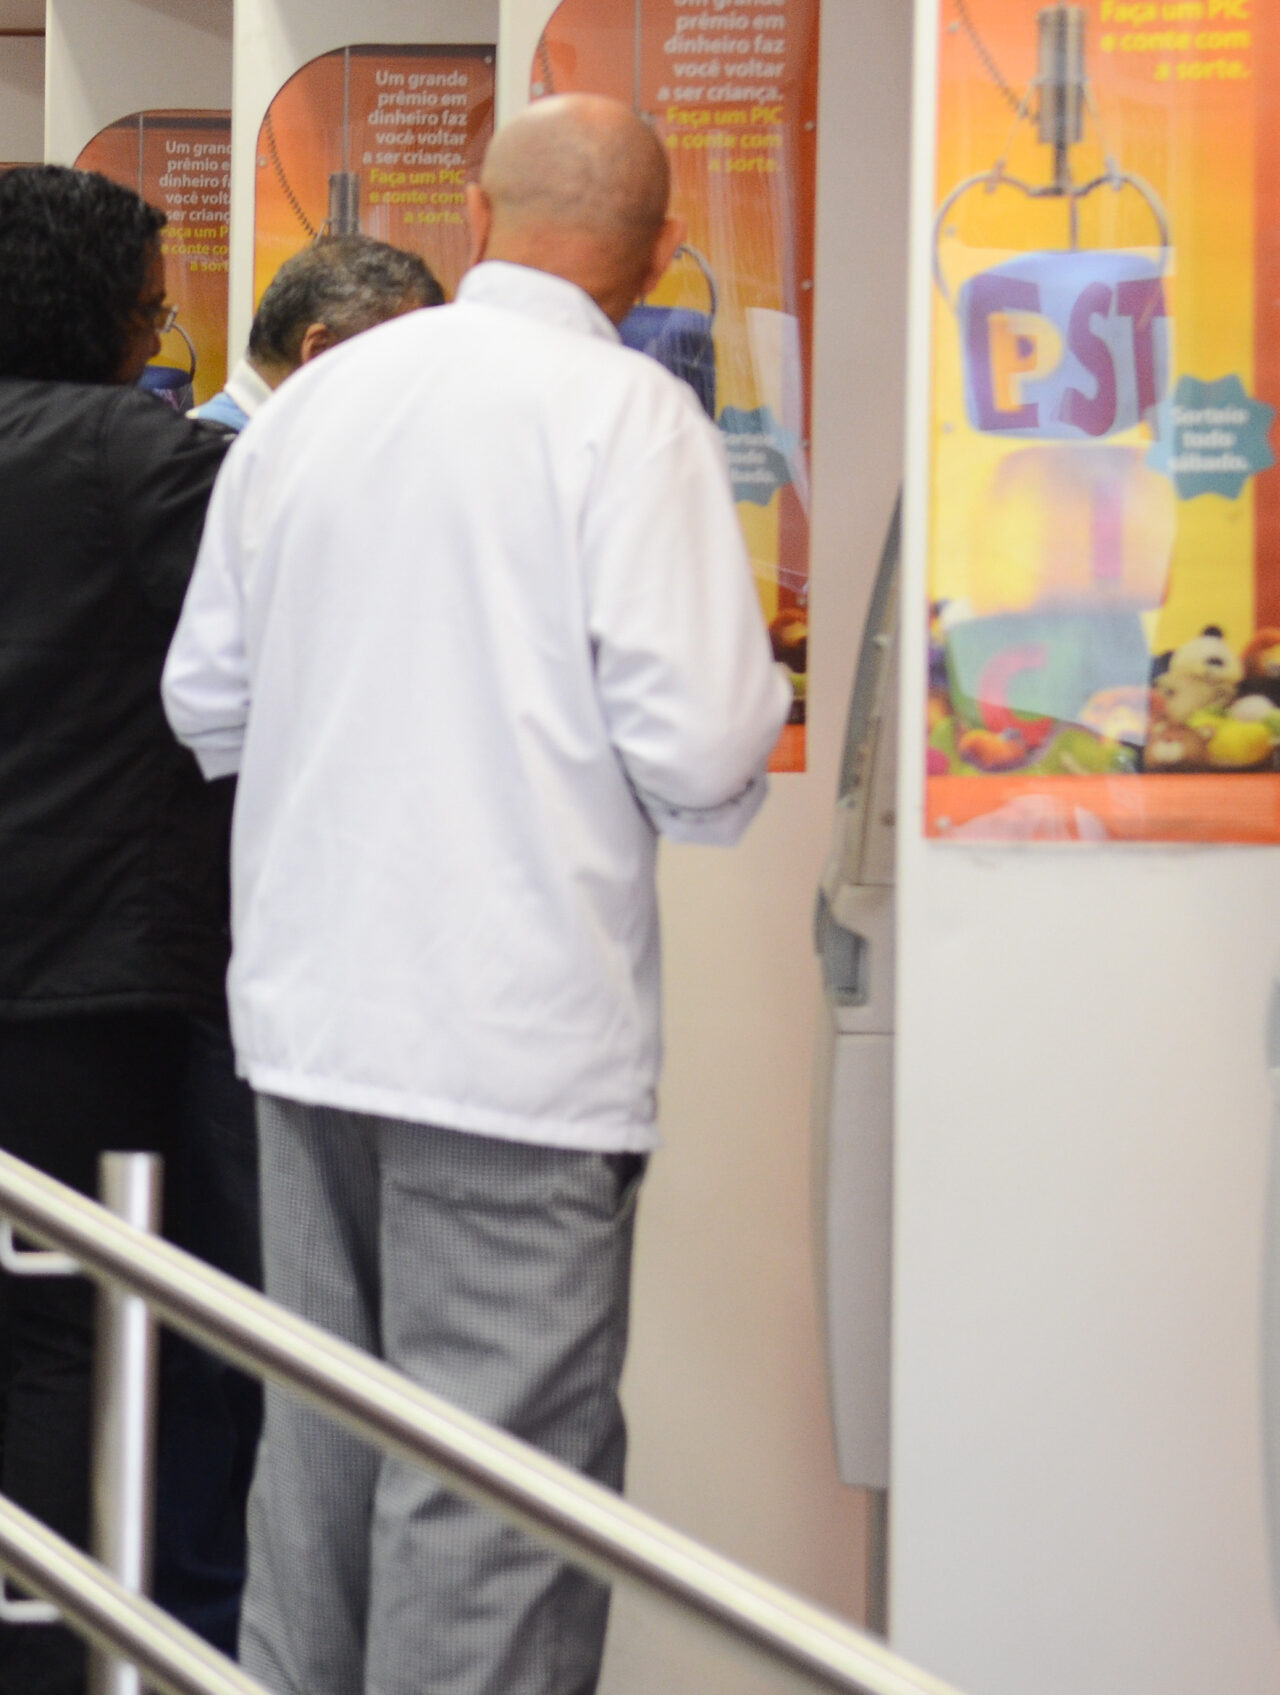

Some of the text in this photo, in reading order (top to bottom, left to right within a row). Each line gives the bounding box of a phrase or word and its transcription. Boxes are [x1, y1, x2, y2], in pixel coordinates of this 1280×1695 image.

[675, 12, 787, 34] prêmio em
[663, 34, 786, 55] dinheiro faz
[673, 59, 786, 78] você voltar
[375, 70, 468, 90] Um grande
[377, 90, 468, 109] prêmio em
[657, 85, 670, 101] a
[673, 85, 704, 101] ser
[368, 108, 468, 127] dinheiro faz
[666, 106, 711, 129] Faça
[713, 110, 747, 125] um
[375, 129, 467, 146] você voltar
[165, 140, 190, 154] Um
[167, 157, 219, 173] prêmio
[362, 149, 467, 169] a ser criança.
[159, 173, 219, 188] dinheiro
[370, 168, 465, 188] Faça um PIC
[165, 190, 199, 204] você
[369, 189, 465, 205] e conte com
[404, 211, 414, 224] a
[194, 228, 217, 238] um
[171, 242, 210, 255] conte
